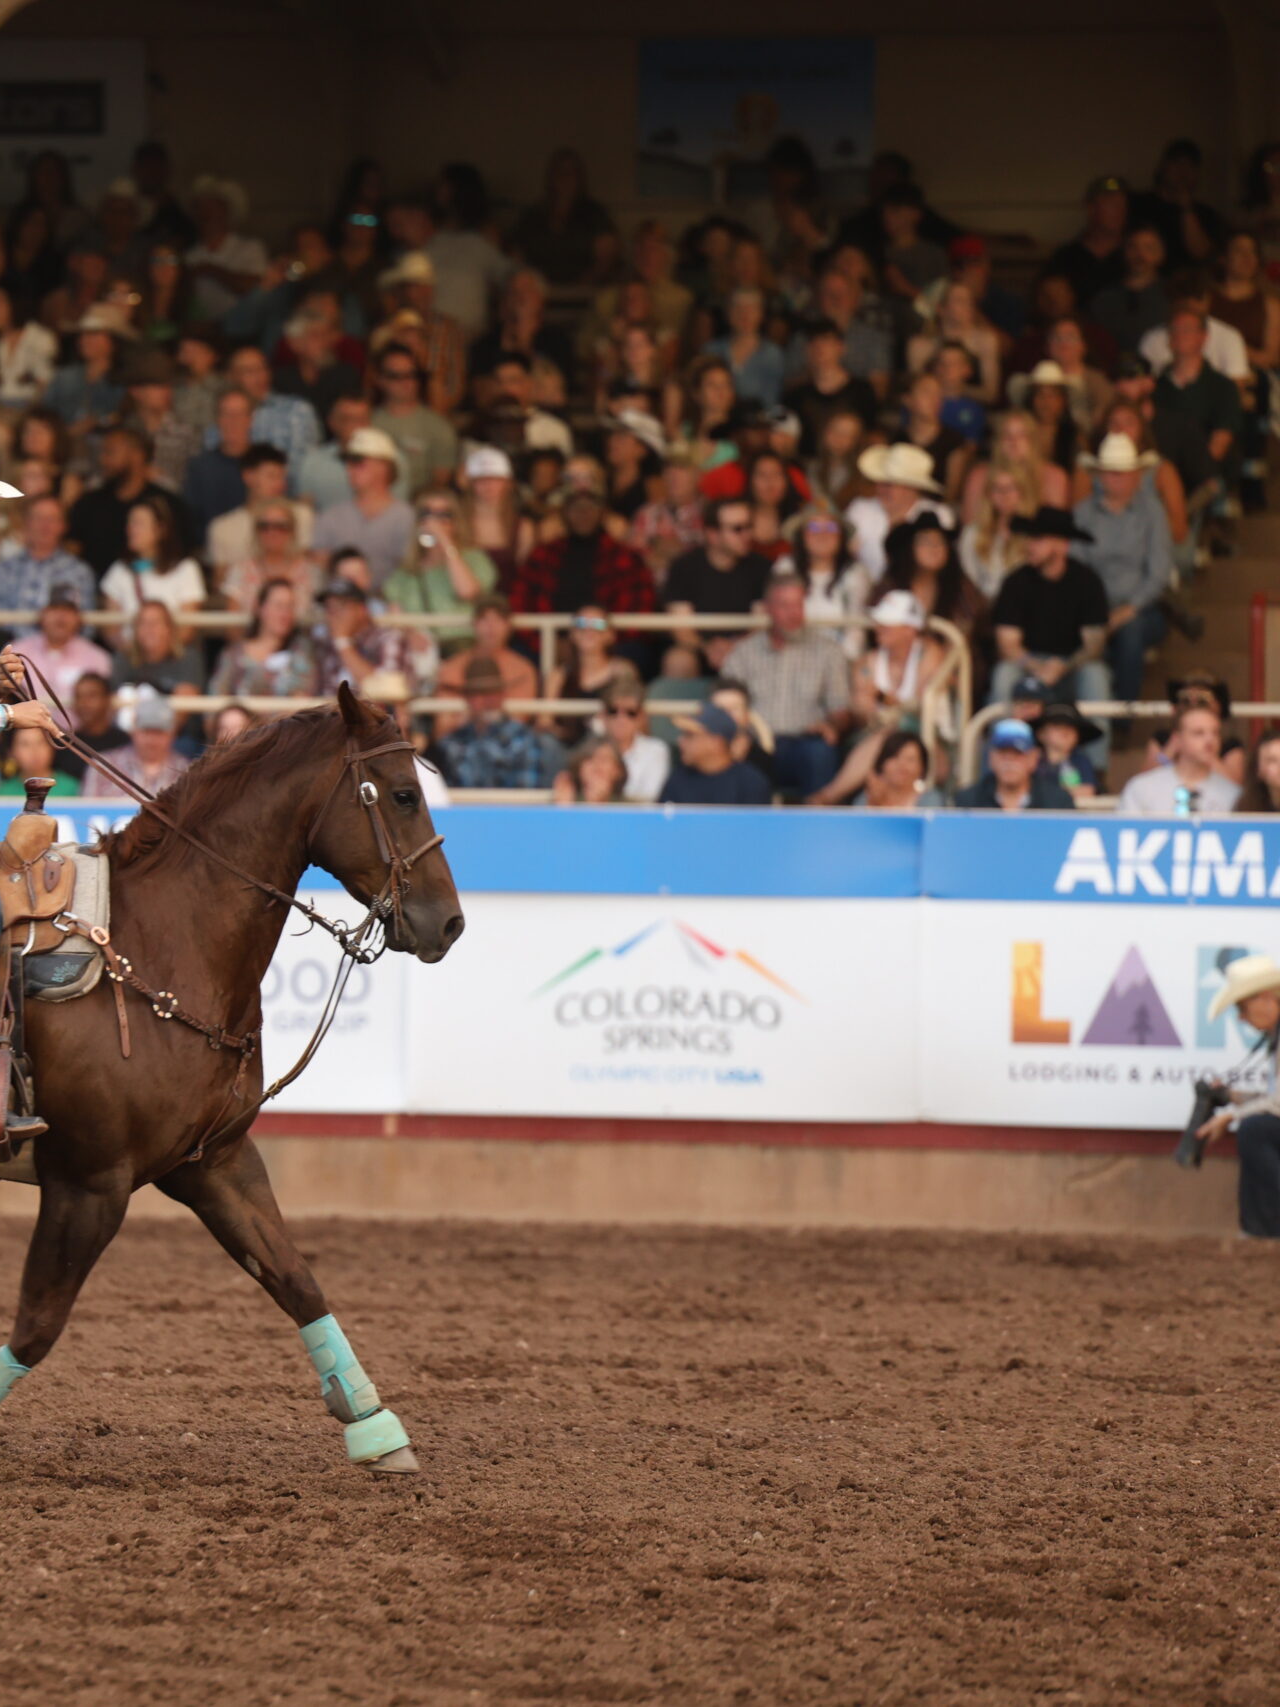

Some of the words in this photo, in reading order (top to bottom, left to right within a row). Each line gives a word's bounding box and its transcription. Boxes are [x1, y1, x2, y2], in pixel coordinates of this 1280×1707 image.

[1053, 827, 1280, 898] AKIM
[554, 984, 782, 1031] COLORADO
[602, 1025, 734, 1055] SPRINGS
[713, 1064, 763, 1084] USA
[1008, 1063, 1118, 1082] LODGING
[1128, 1066, 1141, 1083] &
